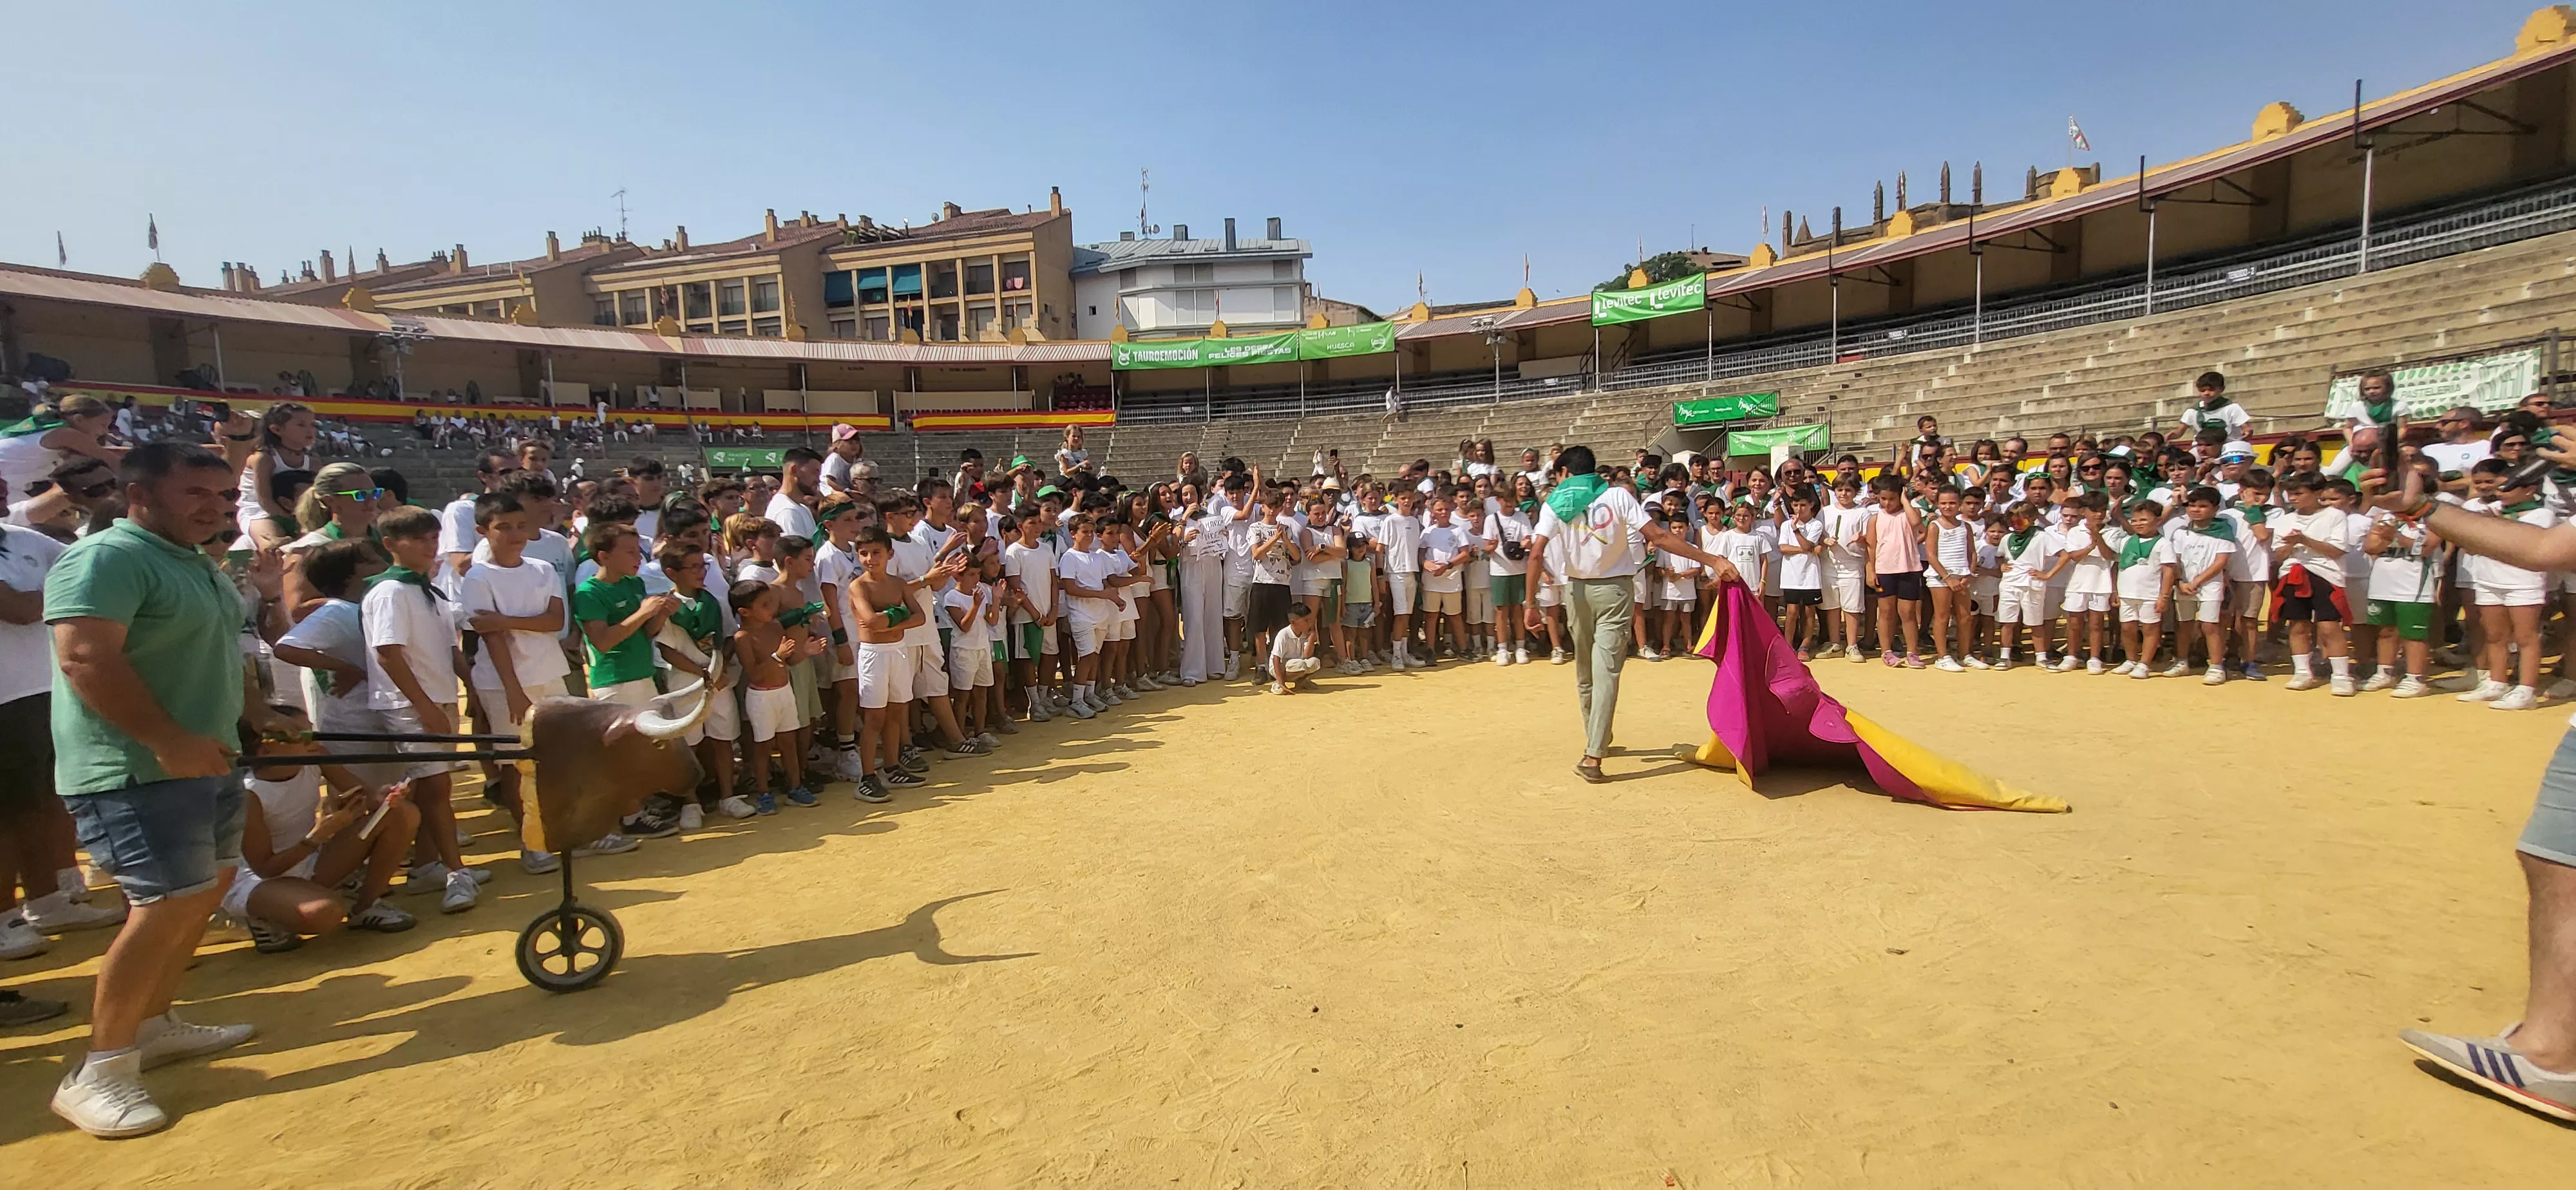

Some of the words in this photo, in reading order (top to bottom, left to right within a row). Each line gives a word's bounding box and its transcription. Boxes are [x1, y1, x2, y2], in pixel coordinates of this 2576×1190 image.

[1327, 342, 1355, 350] HUESCA
[1133, 346, 1198, 362] TAUROEMOCIÓN
[1208, 351, 1249, 359] FELICES
[1251, 348, 1291, 357] FIESTAS
